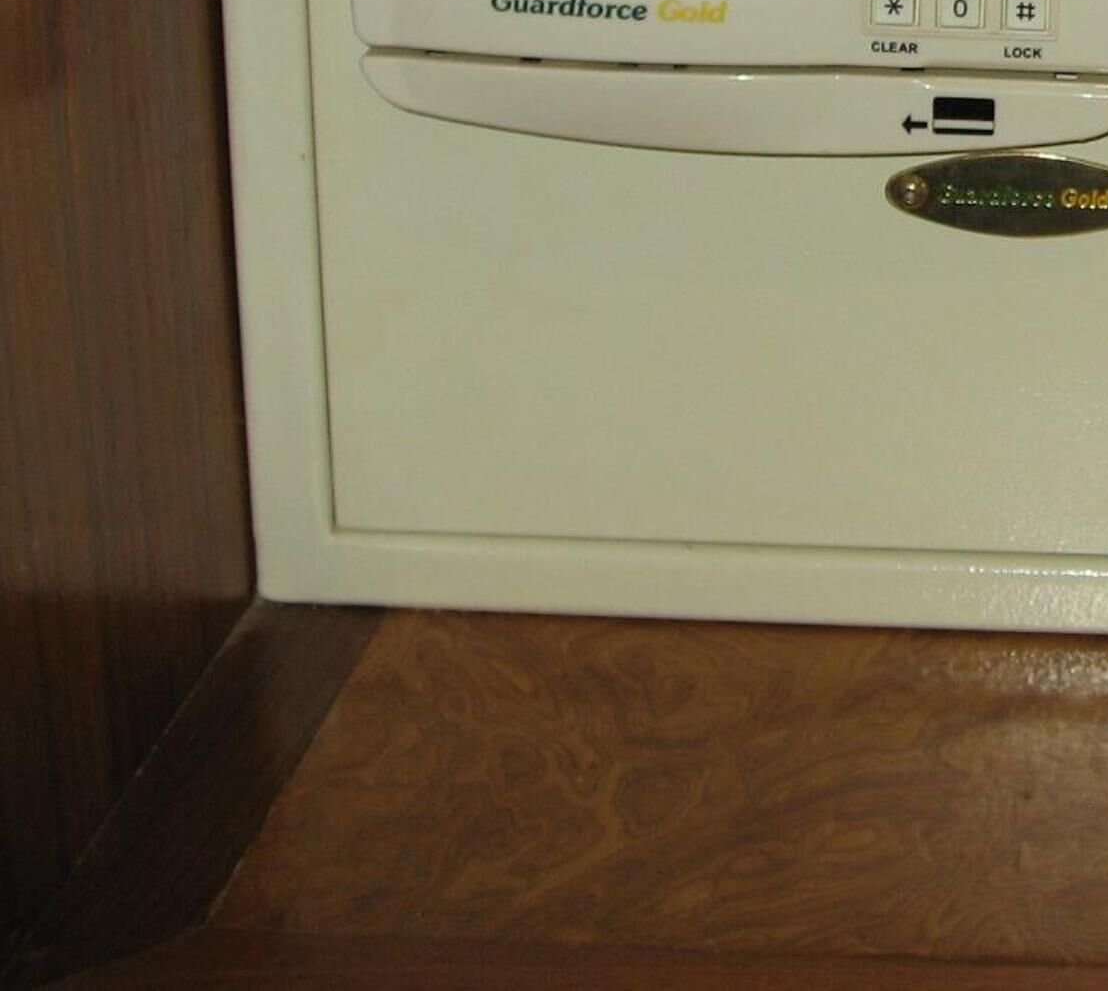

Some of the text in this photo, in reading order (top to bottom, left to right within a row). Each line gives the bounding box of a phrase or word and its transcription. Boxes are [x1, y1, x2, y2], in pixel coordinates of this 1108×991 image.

[954, 0, 968, 18] 0
[1016, 2, 1035, 21] #
[871, 41, 918, 53] CLEAR
[1004, 48, 1042, 59] LOCK
